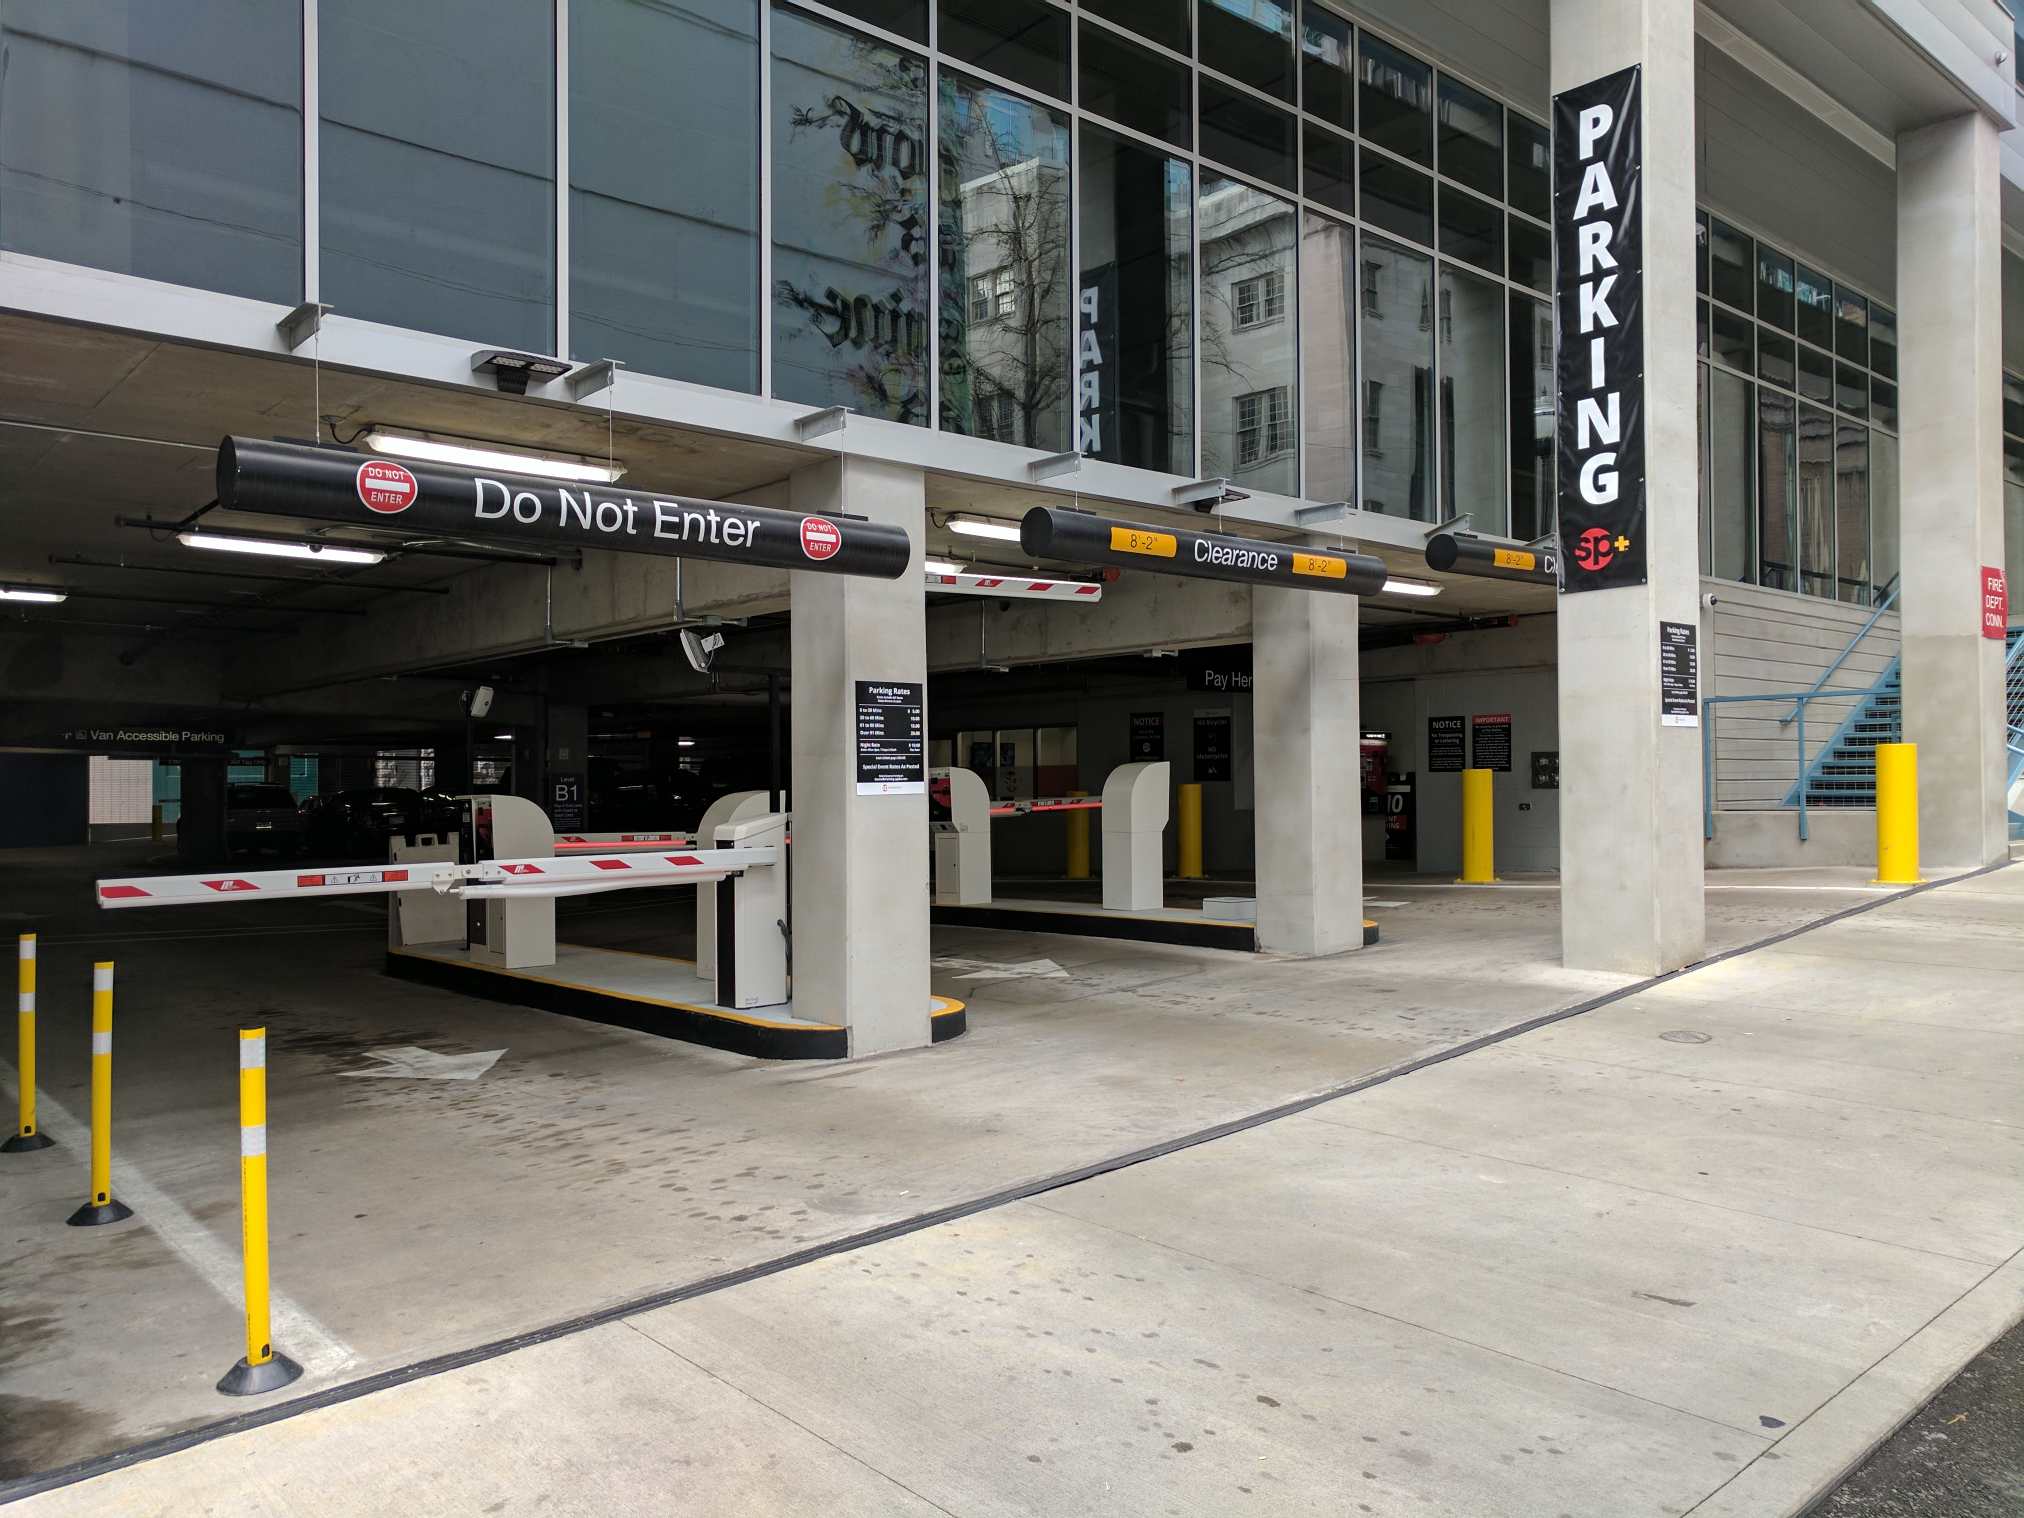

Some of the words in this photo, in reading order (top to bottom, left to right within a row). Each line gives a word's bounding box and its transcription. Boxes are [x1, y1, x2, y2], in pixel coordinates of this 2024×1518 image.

[1573, 104, 1620, 505] PARKING
[368, 467, 382, 477] DO
[385, 469, 405, 480] NOT
[370, 491, 403, 504] ENTER
[474, 478, 542, 524] Do
[558, 488, 638, 535] Not
[653, 500, 760, 547] Enter
[807, 522, 817, 531] DO
[817, 524, 832, 533] NOT
[809, 542, 832, 552] ENTER
[1194, 539, 1278, 571] Clearance
[1987, 577, 2003, 592] FIRE
[1205, 670, 1228, 690] Pay
[869, 686, 893, 695] Parking
[893, 687, 911, 695] Rates
[1432, 720, 1462, 729] NOTICE
[90, 729, 114, 741] Van
[116, 730, 180, 742] Accessible
[181, 731, 225, 744] Parking
[555, 784, 577, 801] B1
